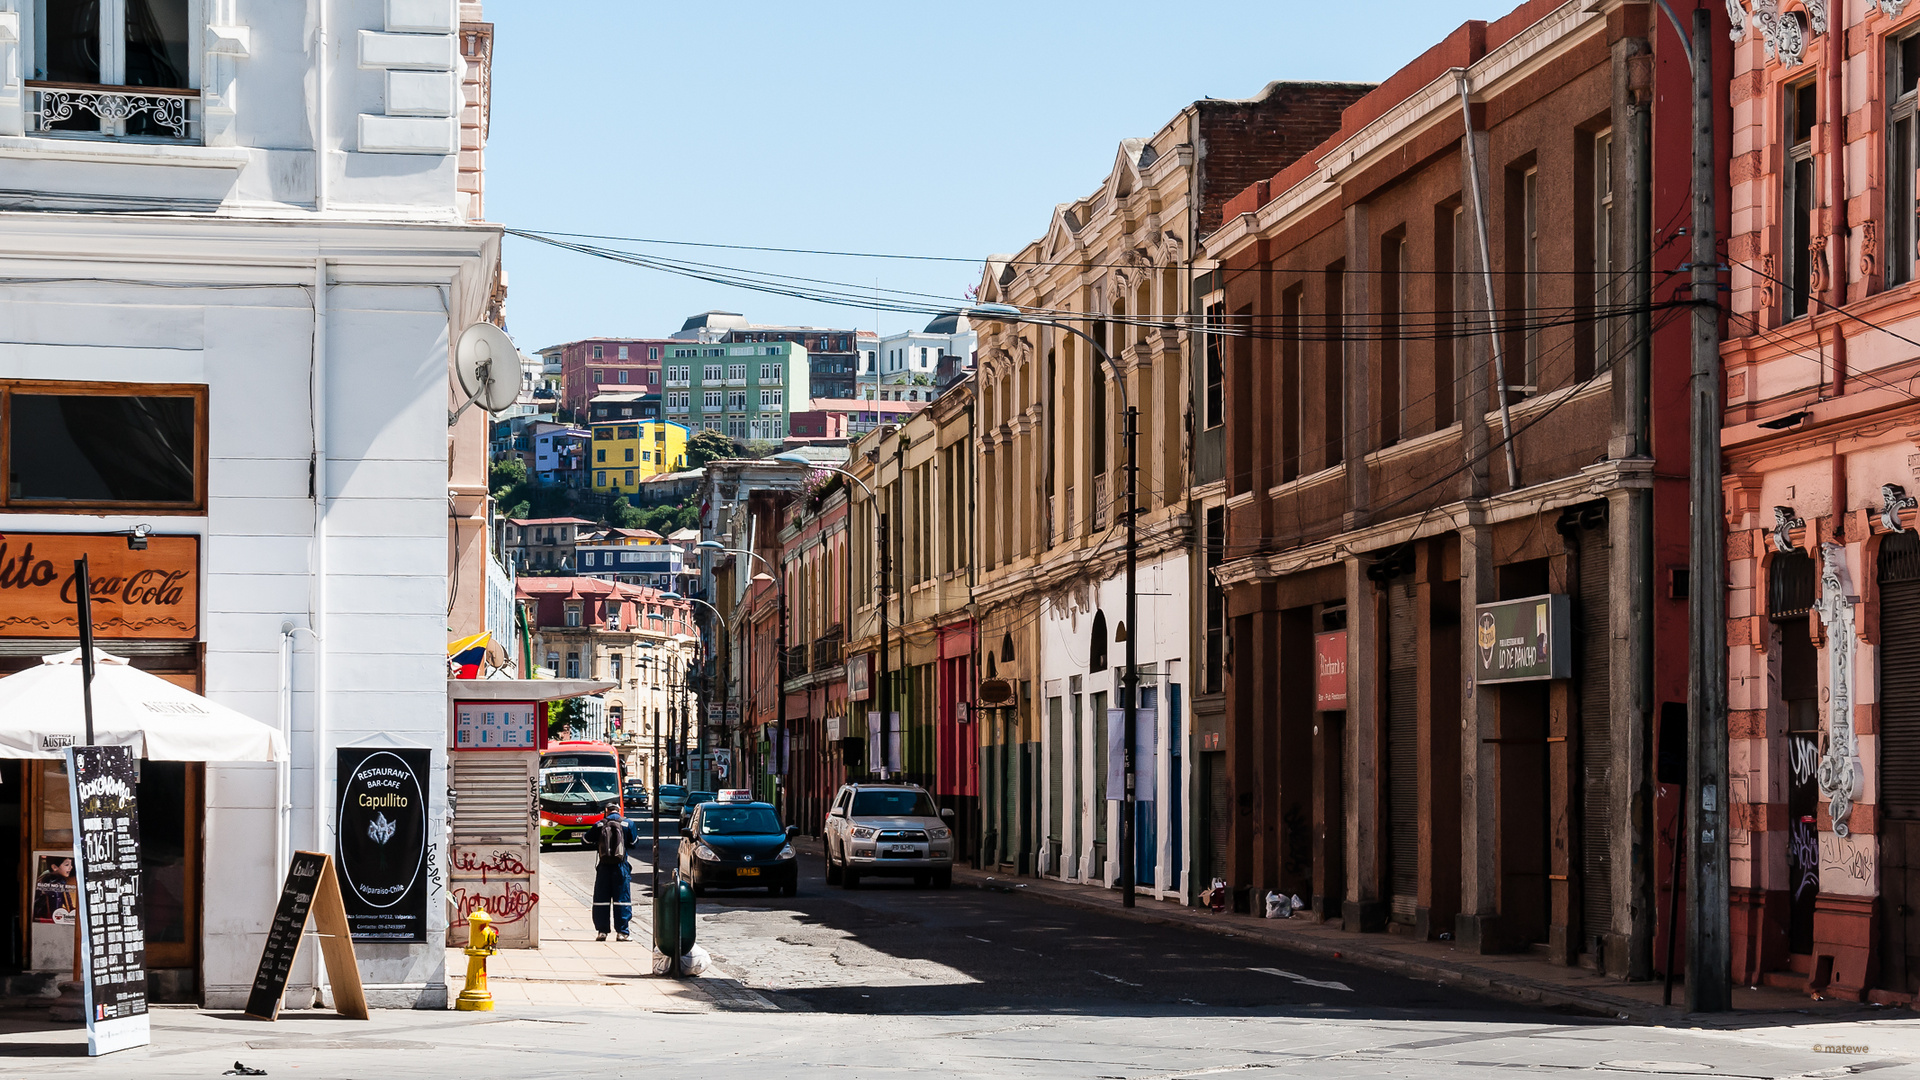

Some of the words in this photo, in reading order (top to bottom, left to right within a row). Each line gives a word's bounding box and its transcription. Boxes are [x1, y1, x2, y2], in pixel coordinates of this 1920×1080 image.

[1506, 648, 1514, 670] DE
[1515, 646, 1537, 669] PANCHO
[357, 768, 410, 781] RESTAURANT
[367, 779, 400, 789] BAR-CAFE
[359, 792, 408, 811] Capullito
